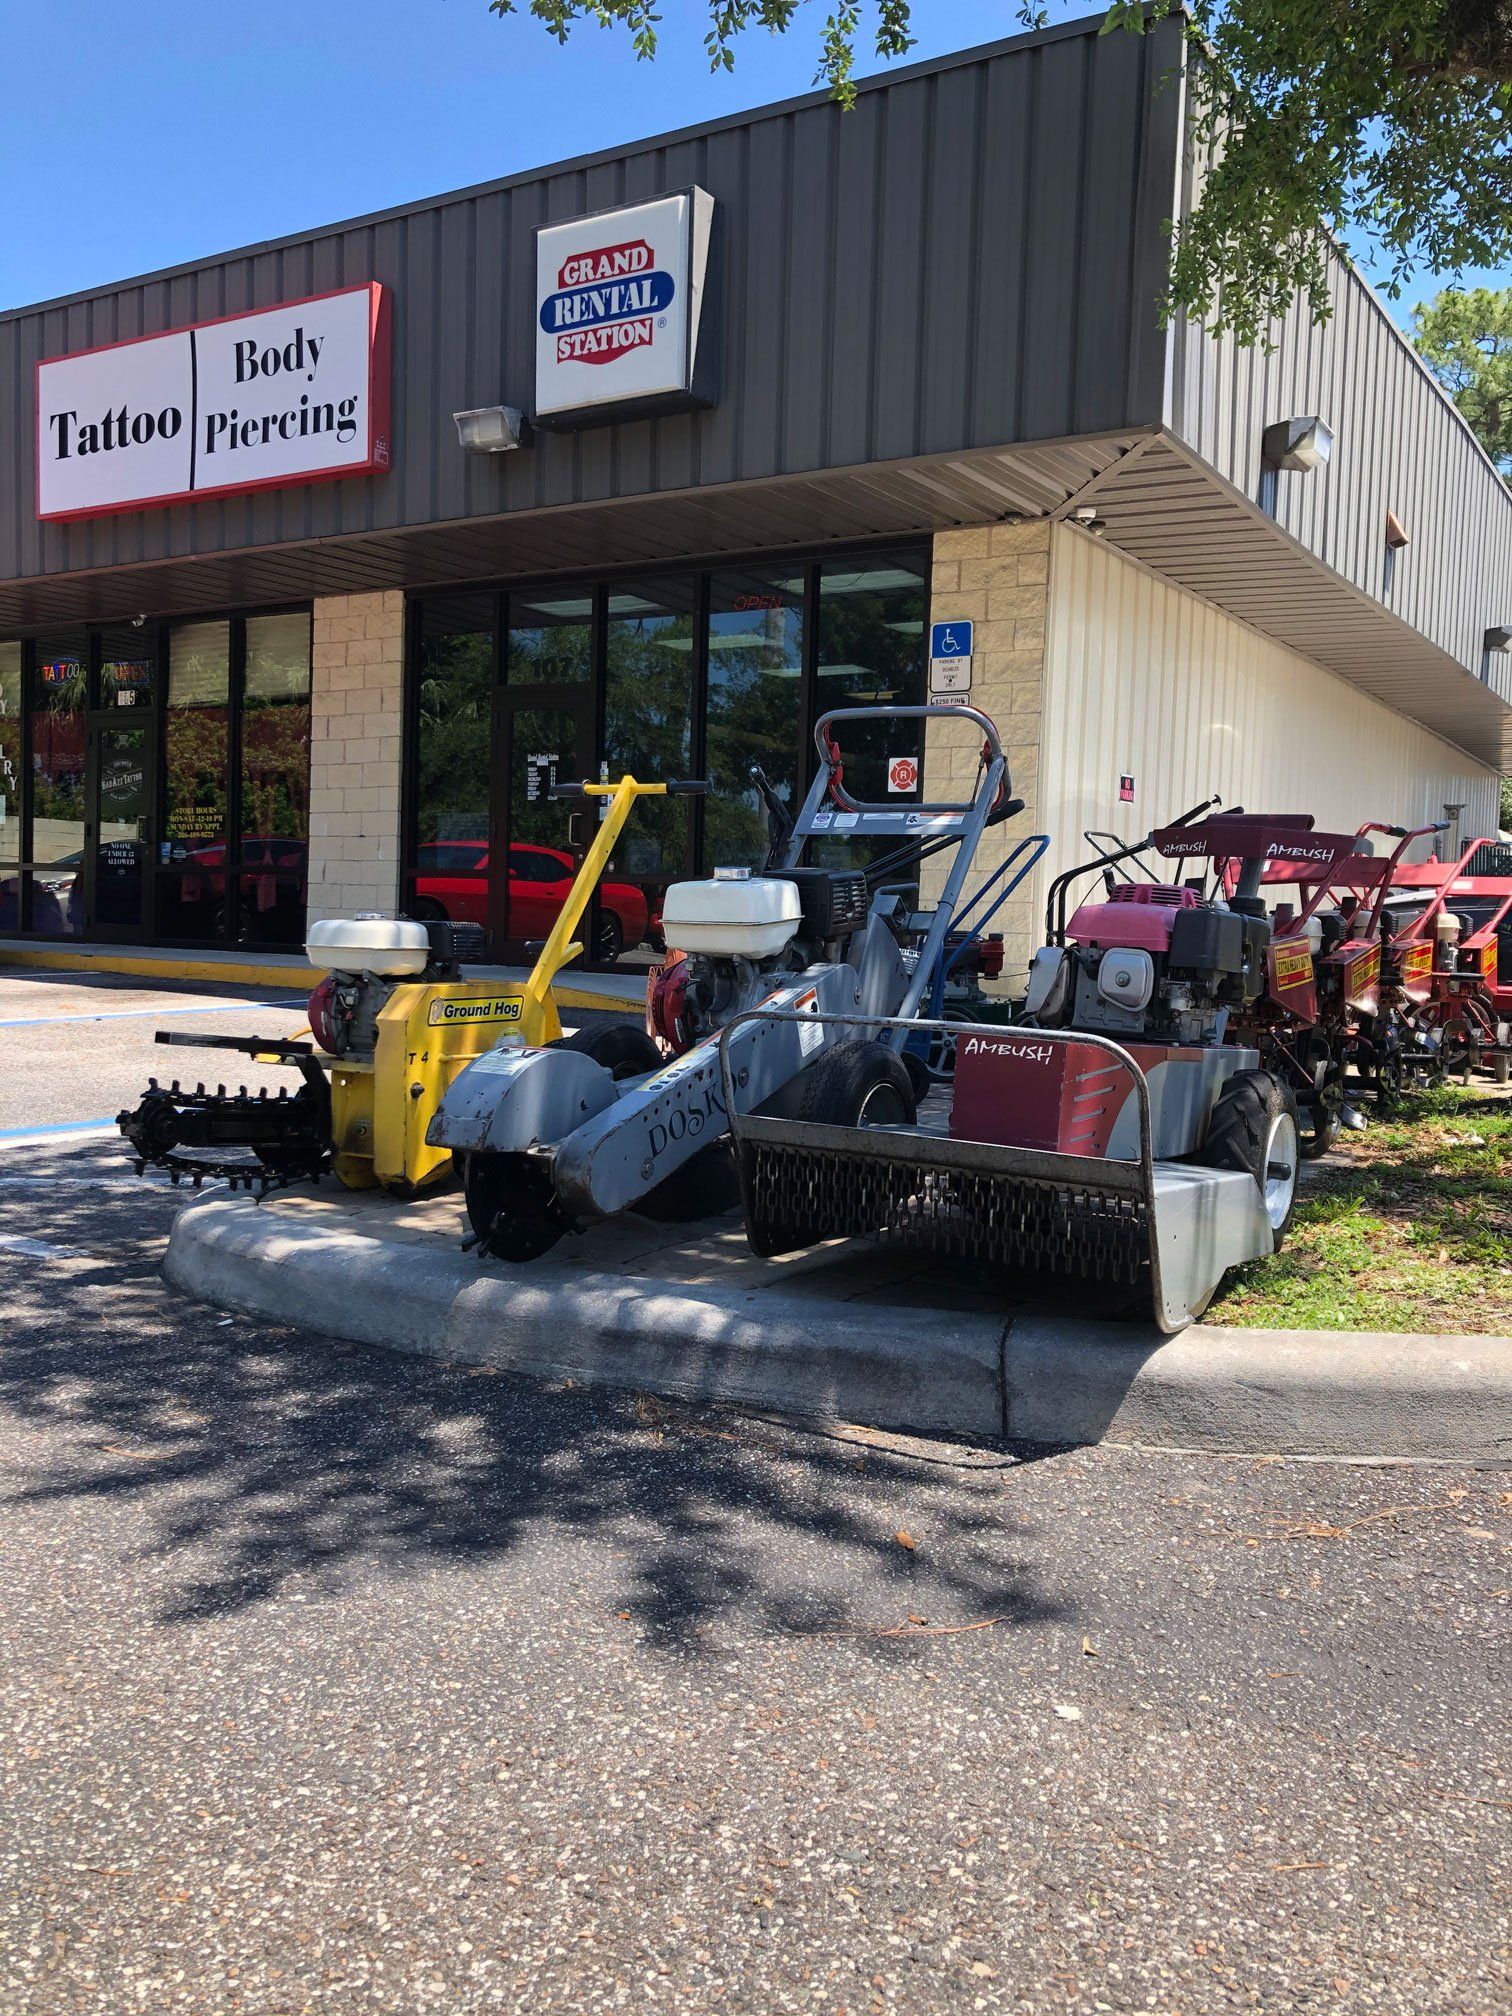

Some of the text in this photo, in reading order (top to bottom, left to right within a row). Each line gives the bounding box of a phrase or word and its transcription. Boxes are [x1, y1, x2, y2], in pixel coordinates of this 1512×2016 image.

[563, 246, 649, 286] GRAND
[553, 279, 659, 327] RENTAL
[558, 319, 652, 359] STATION
[233, 327, 325, 384] Body
[49, 404, 182, 460] Tattoo
[204, 394, 359, 456] Piercing
[734, 594, 783, 611] OPEN
[42, 663, 80, 681] TATTOO
[900, 770, 907, 780] R
[1163, 840, 1207, 854] AMBUSH
[1266, 842, 1335, 863] AMBUSH
[444, 1002, 519, 1018] Ground Hog
[408, 1051, 429, 1065] T 4
[964, 1038, 1053, 1065] AMBUSH
